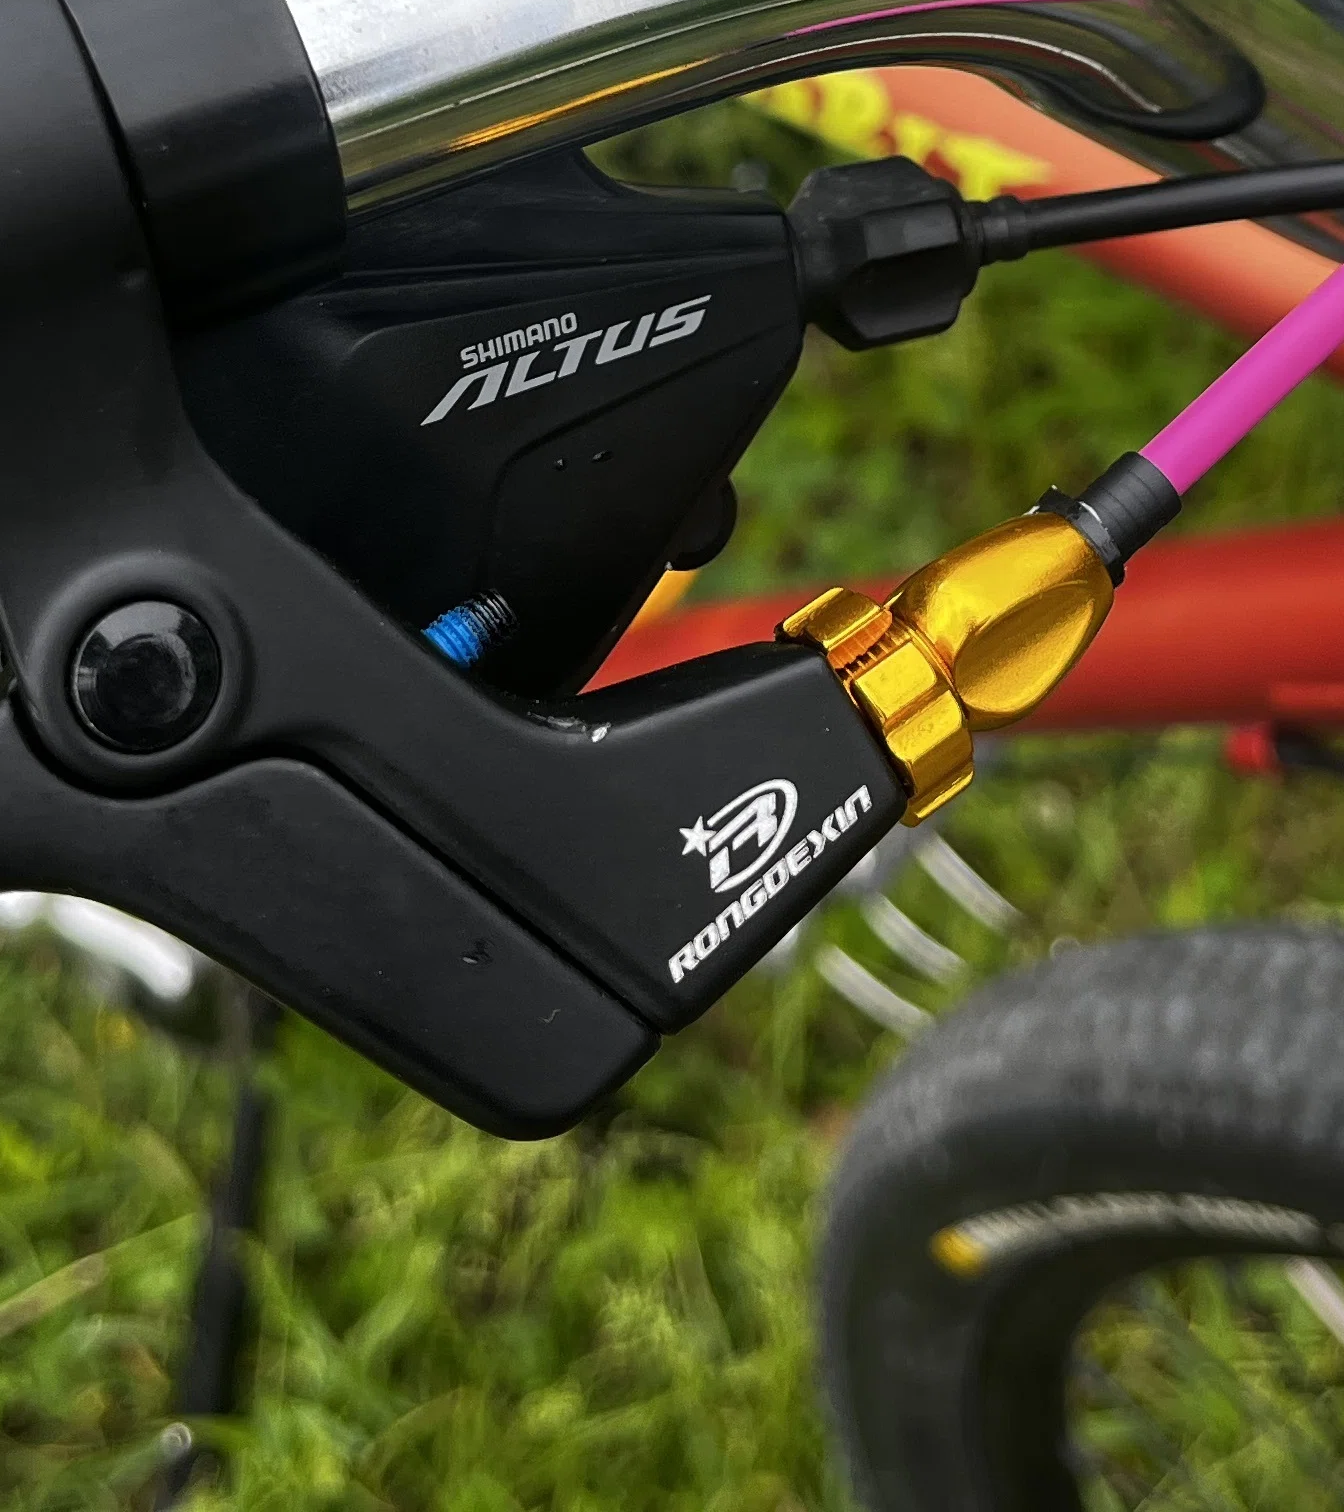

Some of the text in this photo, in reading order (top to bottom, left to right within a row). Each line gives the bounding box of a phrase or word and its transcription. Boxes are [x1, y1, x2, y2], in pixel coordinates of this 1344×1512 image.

[420, 294, 712, 426] ALTUS
[460, 312, 578, 369] SHIMANO
[668, 784, 873, 984] RONGDEXIN
